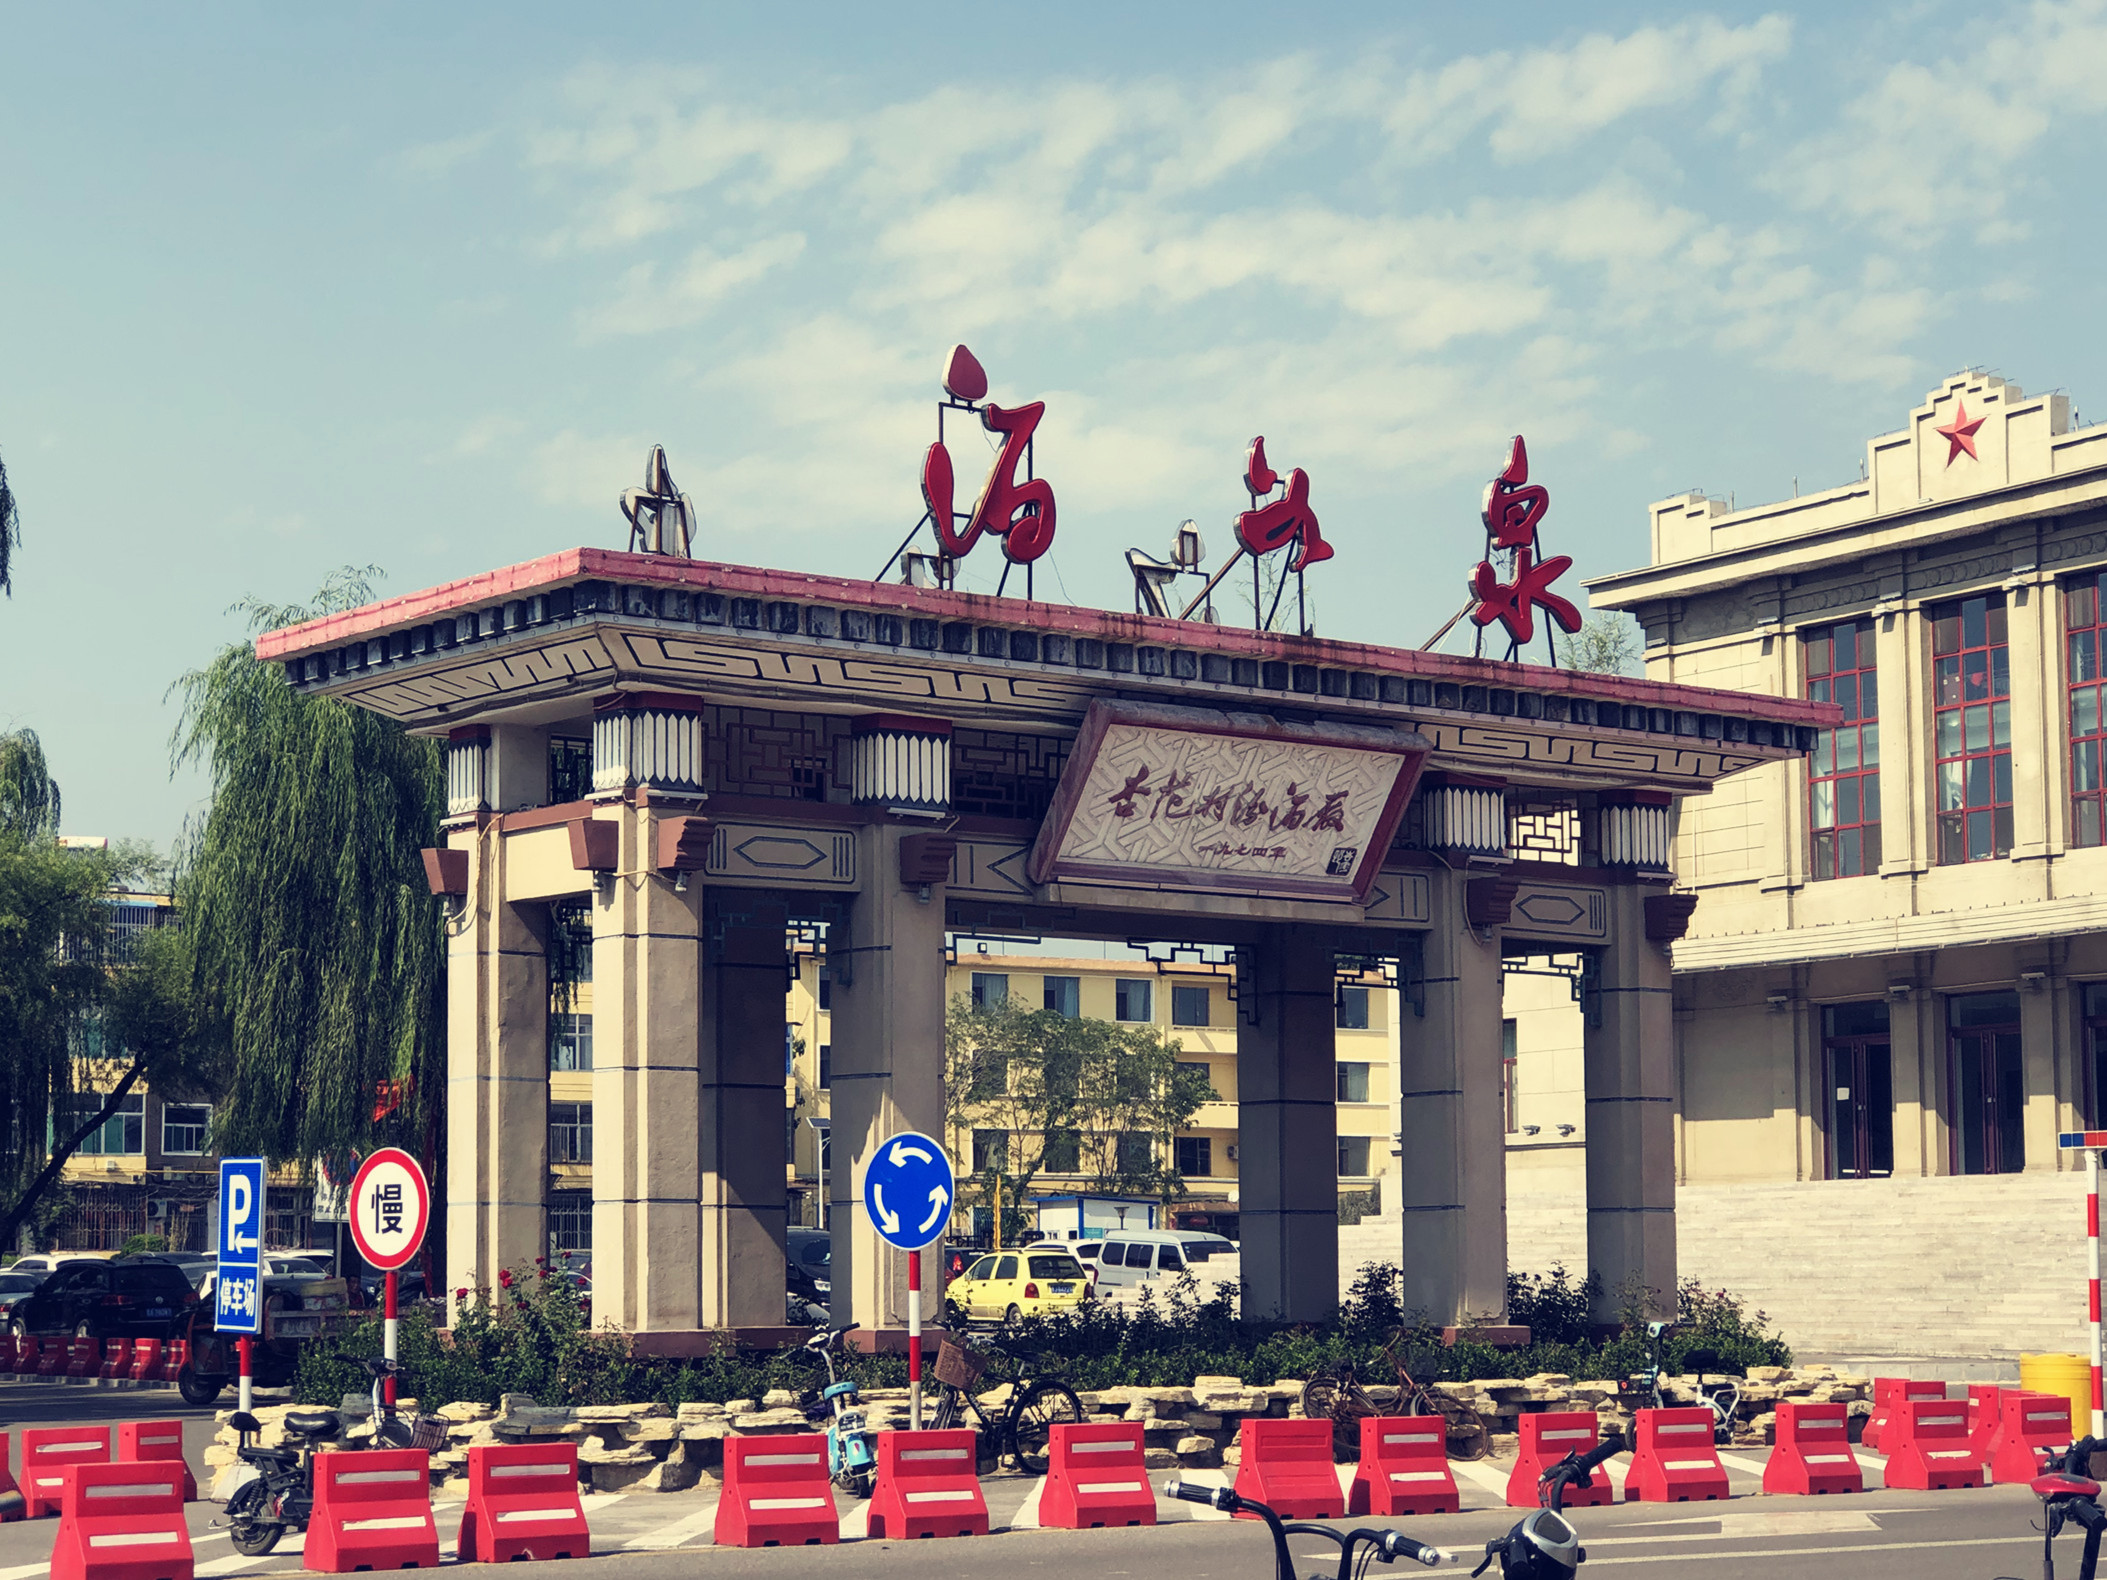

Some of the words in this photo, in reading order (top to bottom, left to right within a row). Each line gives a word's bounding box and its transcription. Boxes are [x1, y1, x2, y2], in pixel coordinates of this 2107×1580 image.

[1199, 841, 1287, 860] 一九七四年
[227, 1174, 252, 1251] P
[371, 1184, 403, 1234] 慢
[220, 1277, 255, 1317] 停车场
